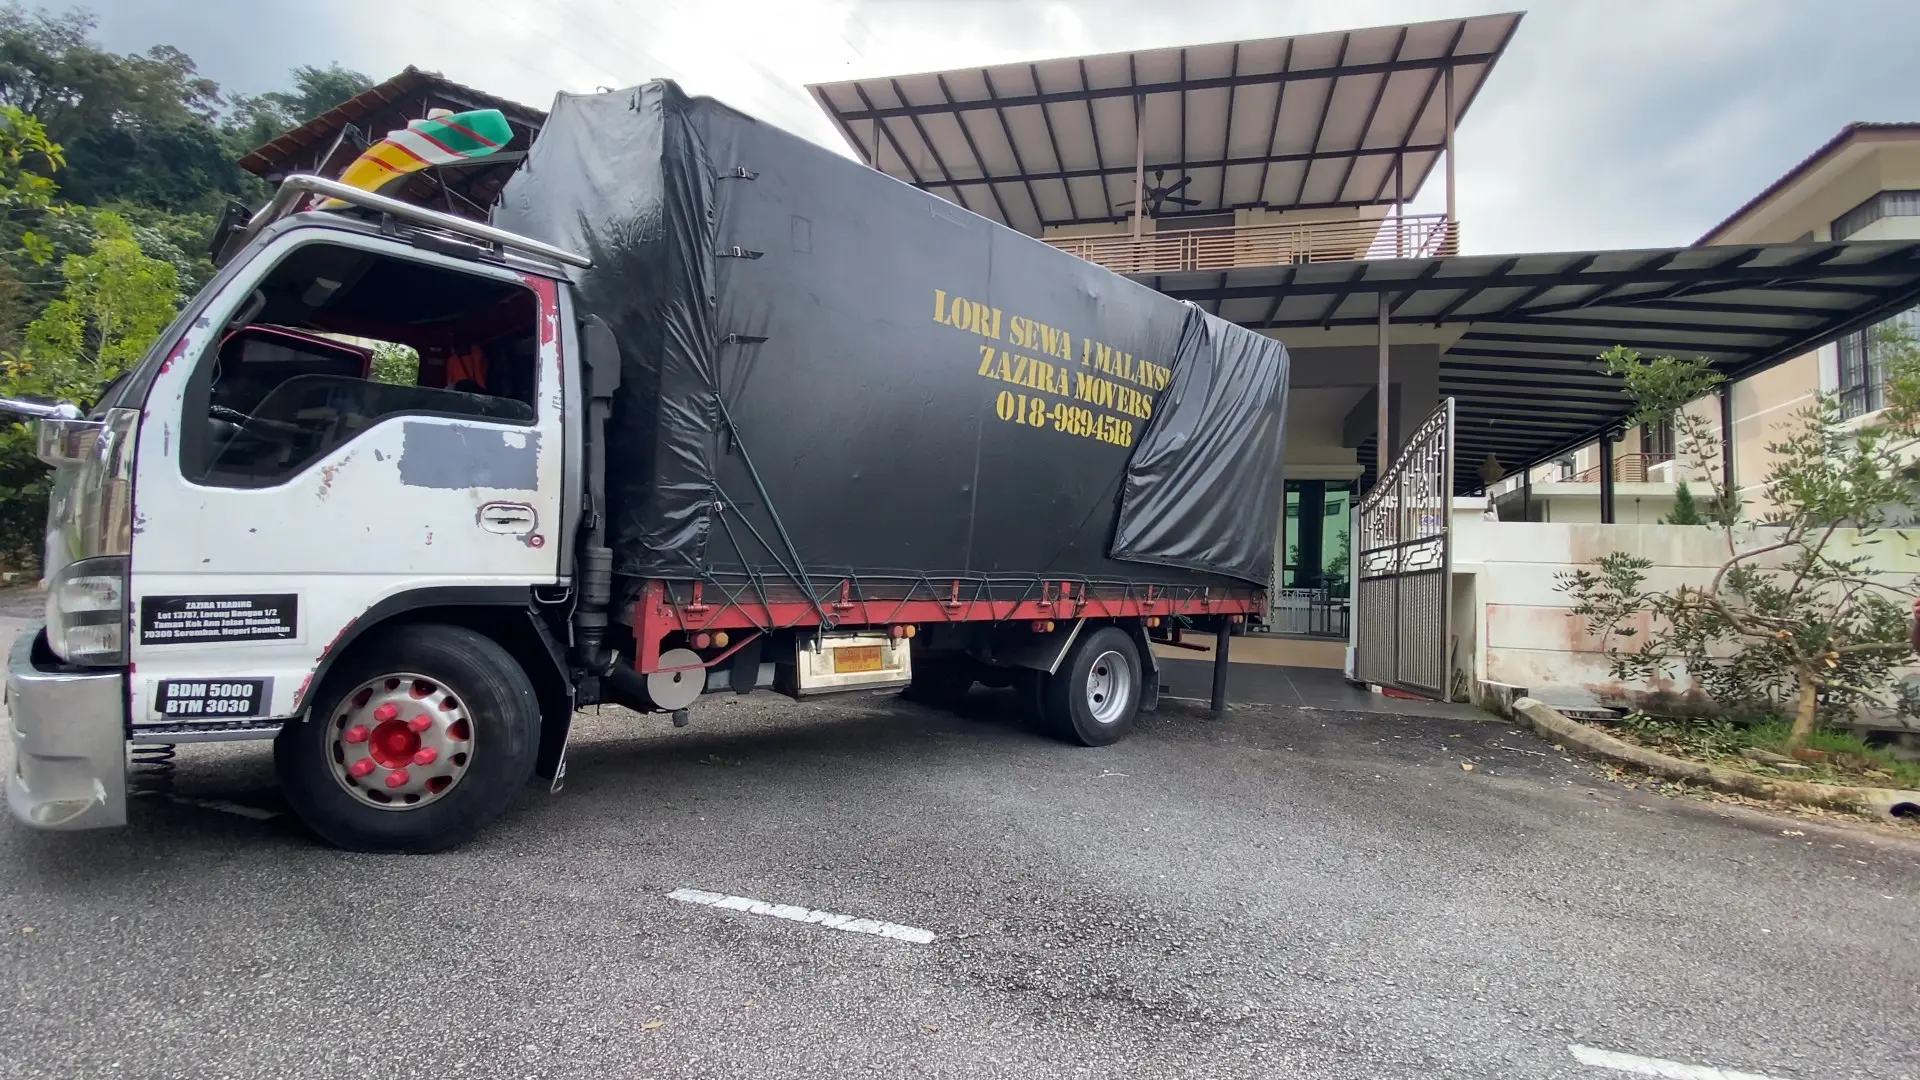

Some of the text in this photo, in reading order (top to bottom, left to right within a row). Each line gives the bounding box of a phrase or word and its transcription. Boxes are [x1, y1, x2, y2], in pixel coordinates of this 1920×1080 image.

[933, 289, 1003, 340] LORI
[1009, 315, 1072, 361] SEWA
[1094, 341, 1172, 392] MALAYSI
[978, 345, 1153, 420] ZAZIRA MOVERS
[996, 390, 1133, 448] 018-9894518
[186, 600, 252, 610] ZAZIRA TRADING
[157, 612, 172, 620] Lot
[264, 608, 278, 617] 1/2
[153, 621, 184, 629] Taman
[167, 683, 254, 697] BDM 5000
[165, 699, 250, 713] BTM 3030
